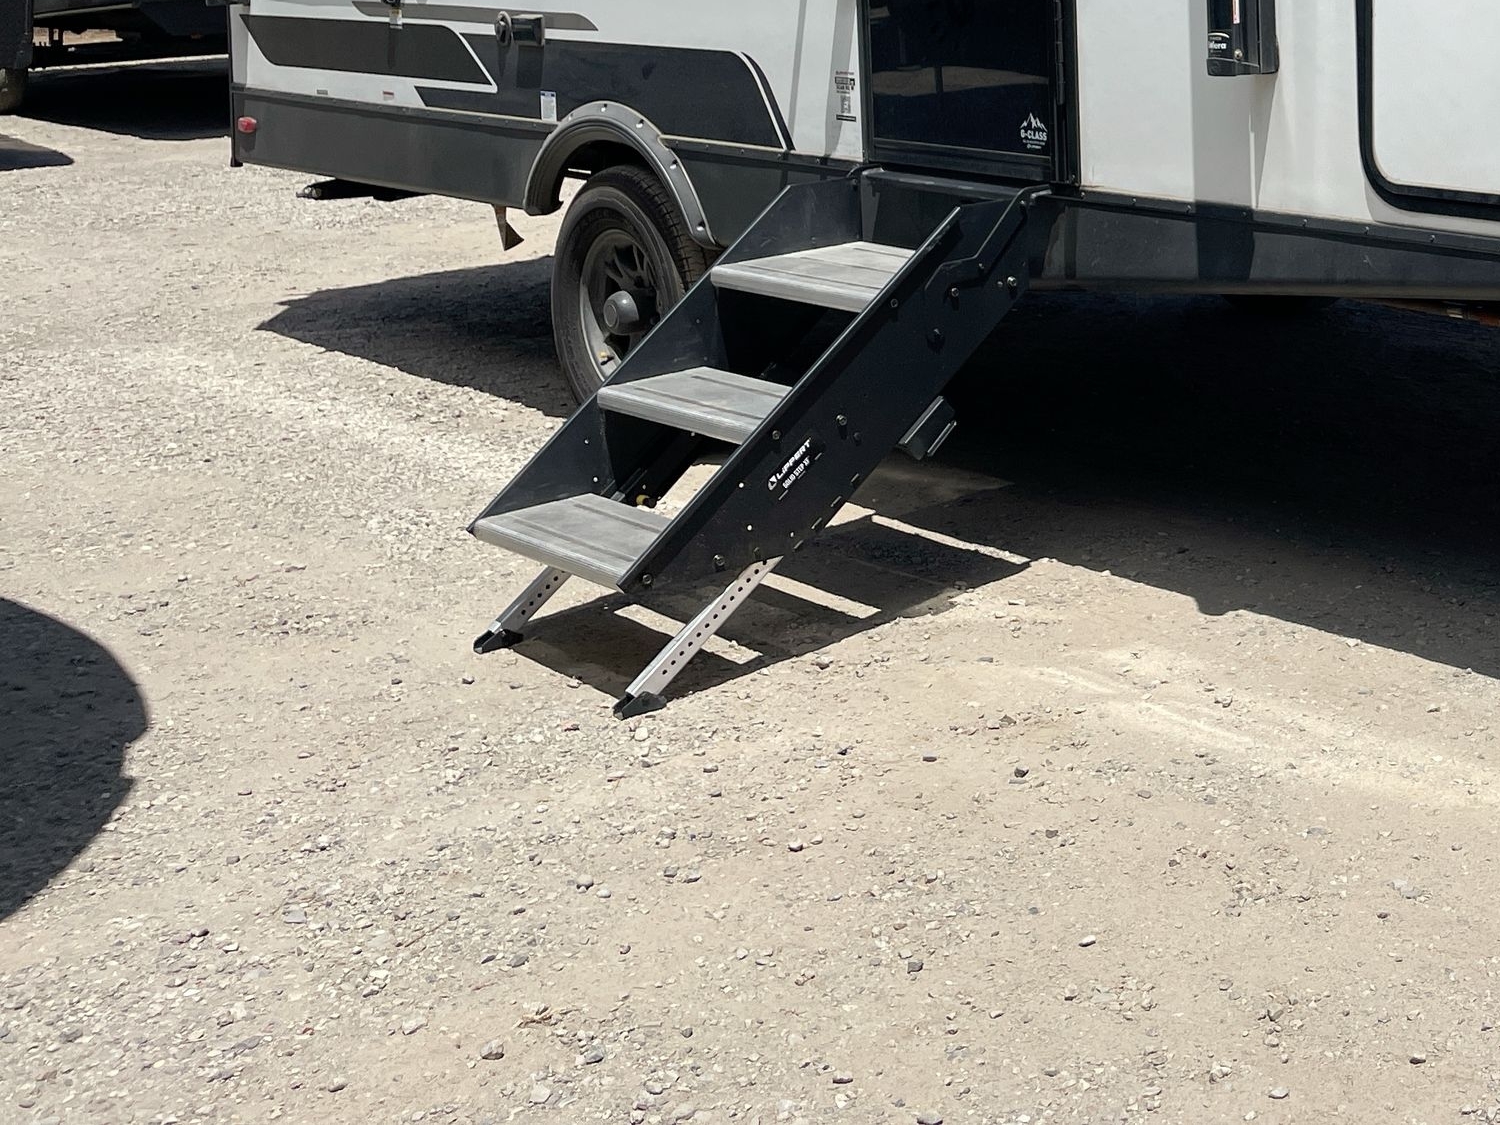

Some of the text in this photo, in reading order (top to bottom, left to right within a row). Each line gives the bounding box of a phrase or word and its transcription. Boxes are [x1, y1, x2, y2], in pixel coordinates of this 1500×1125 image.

[1020, 129, 1047, 141] G-CLASS
[776, 438, 810, 480] LIPPERT
[782, 473, 797, 489] SOLID
[793, 462, 805, 477] STEP
